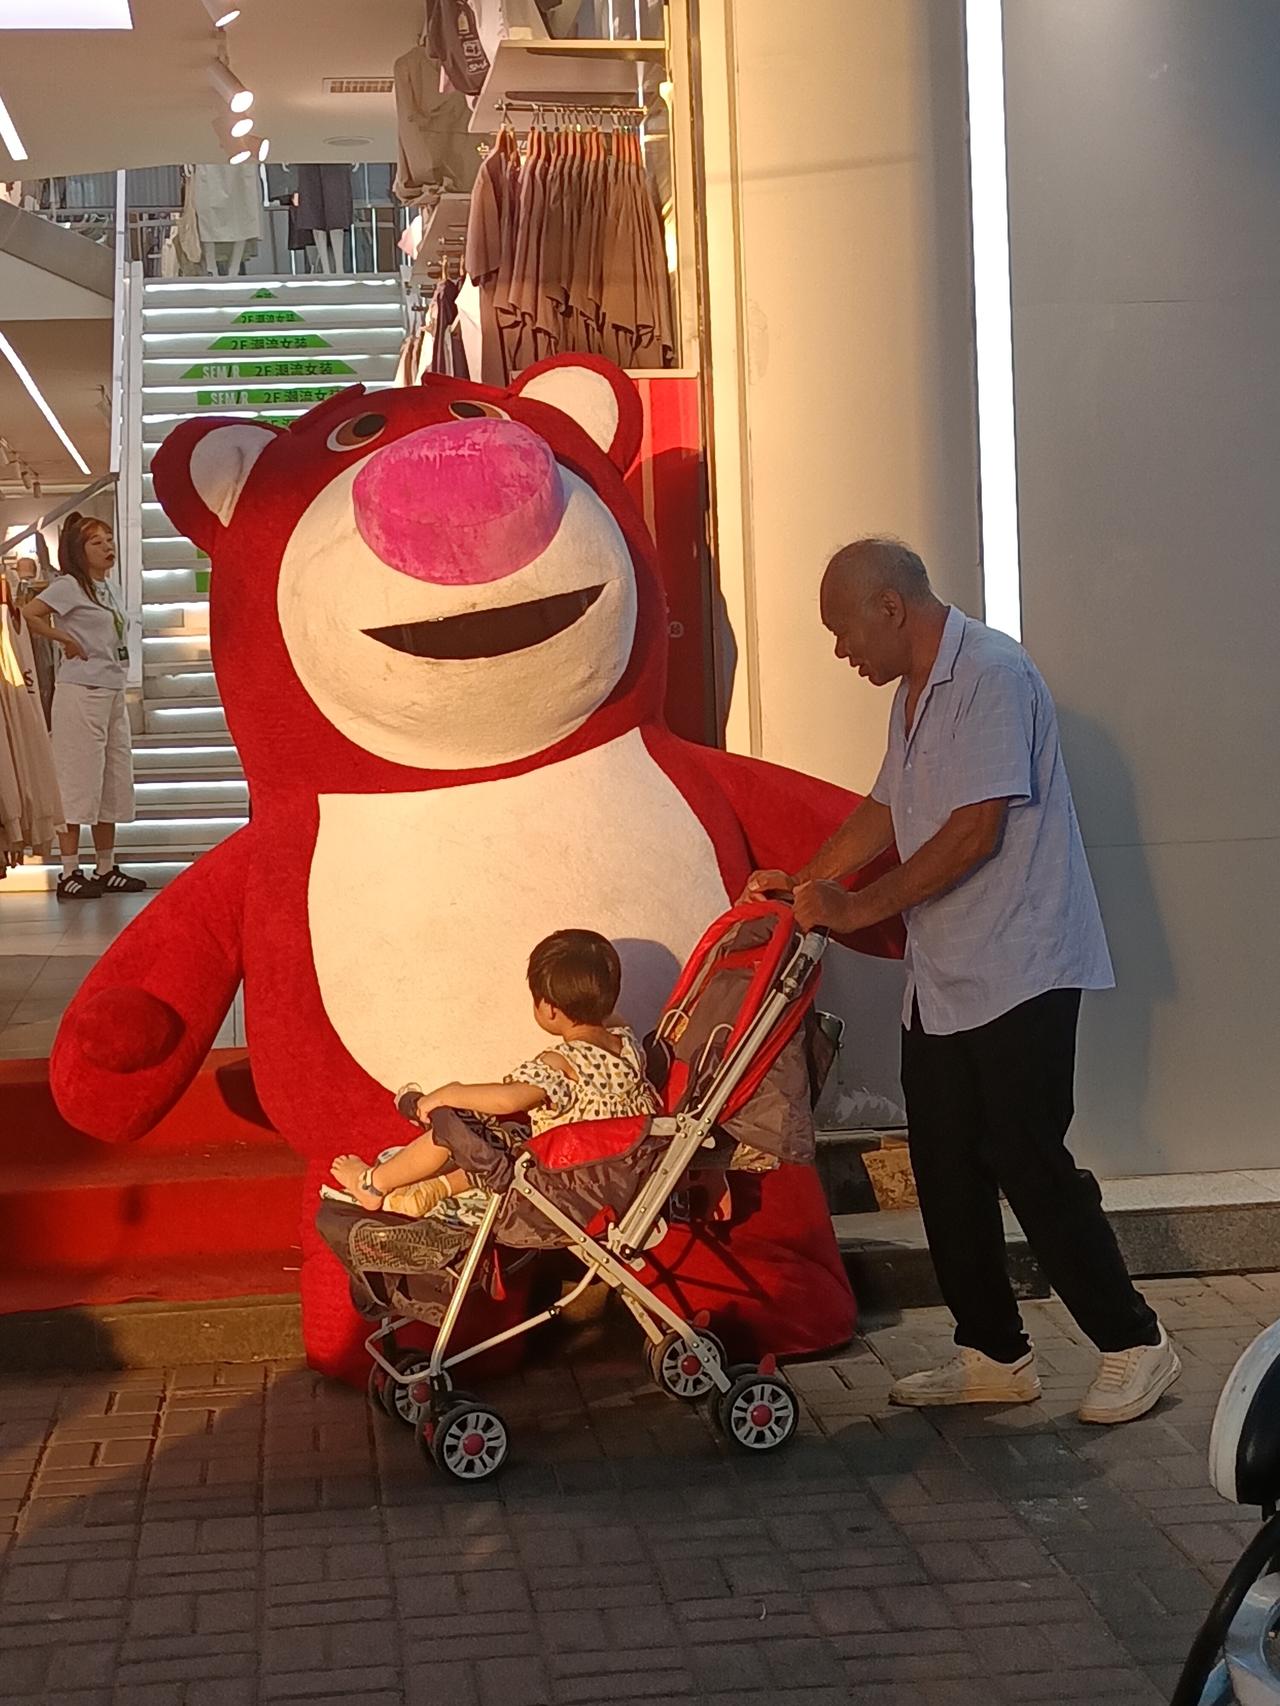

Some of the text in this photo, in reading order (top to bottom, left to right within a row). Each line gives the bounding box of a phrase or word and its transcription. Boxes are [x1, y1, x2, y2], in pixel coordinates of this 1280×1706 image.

[231, 340, 247, 350] 2F
[255, 365, 272, 377] 2F
[275, 362, 332, 376] 潮流女装
[264, 391, 280, 403] 2F
